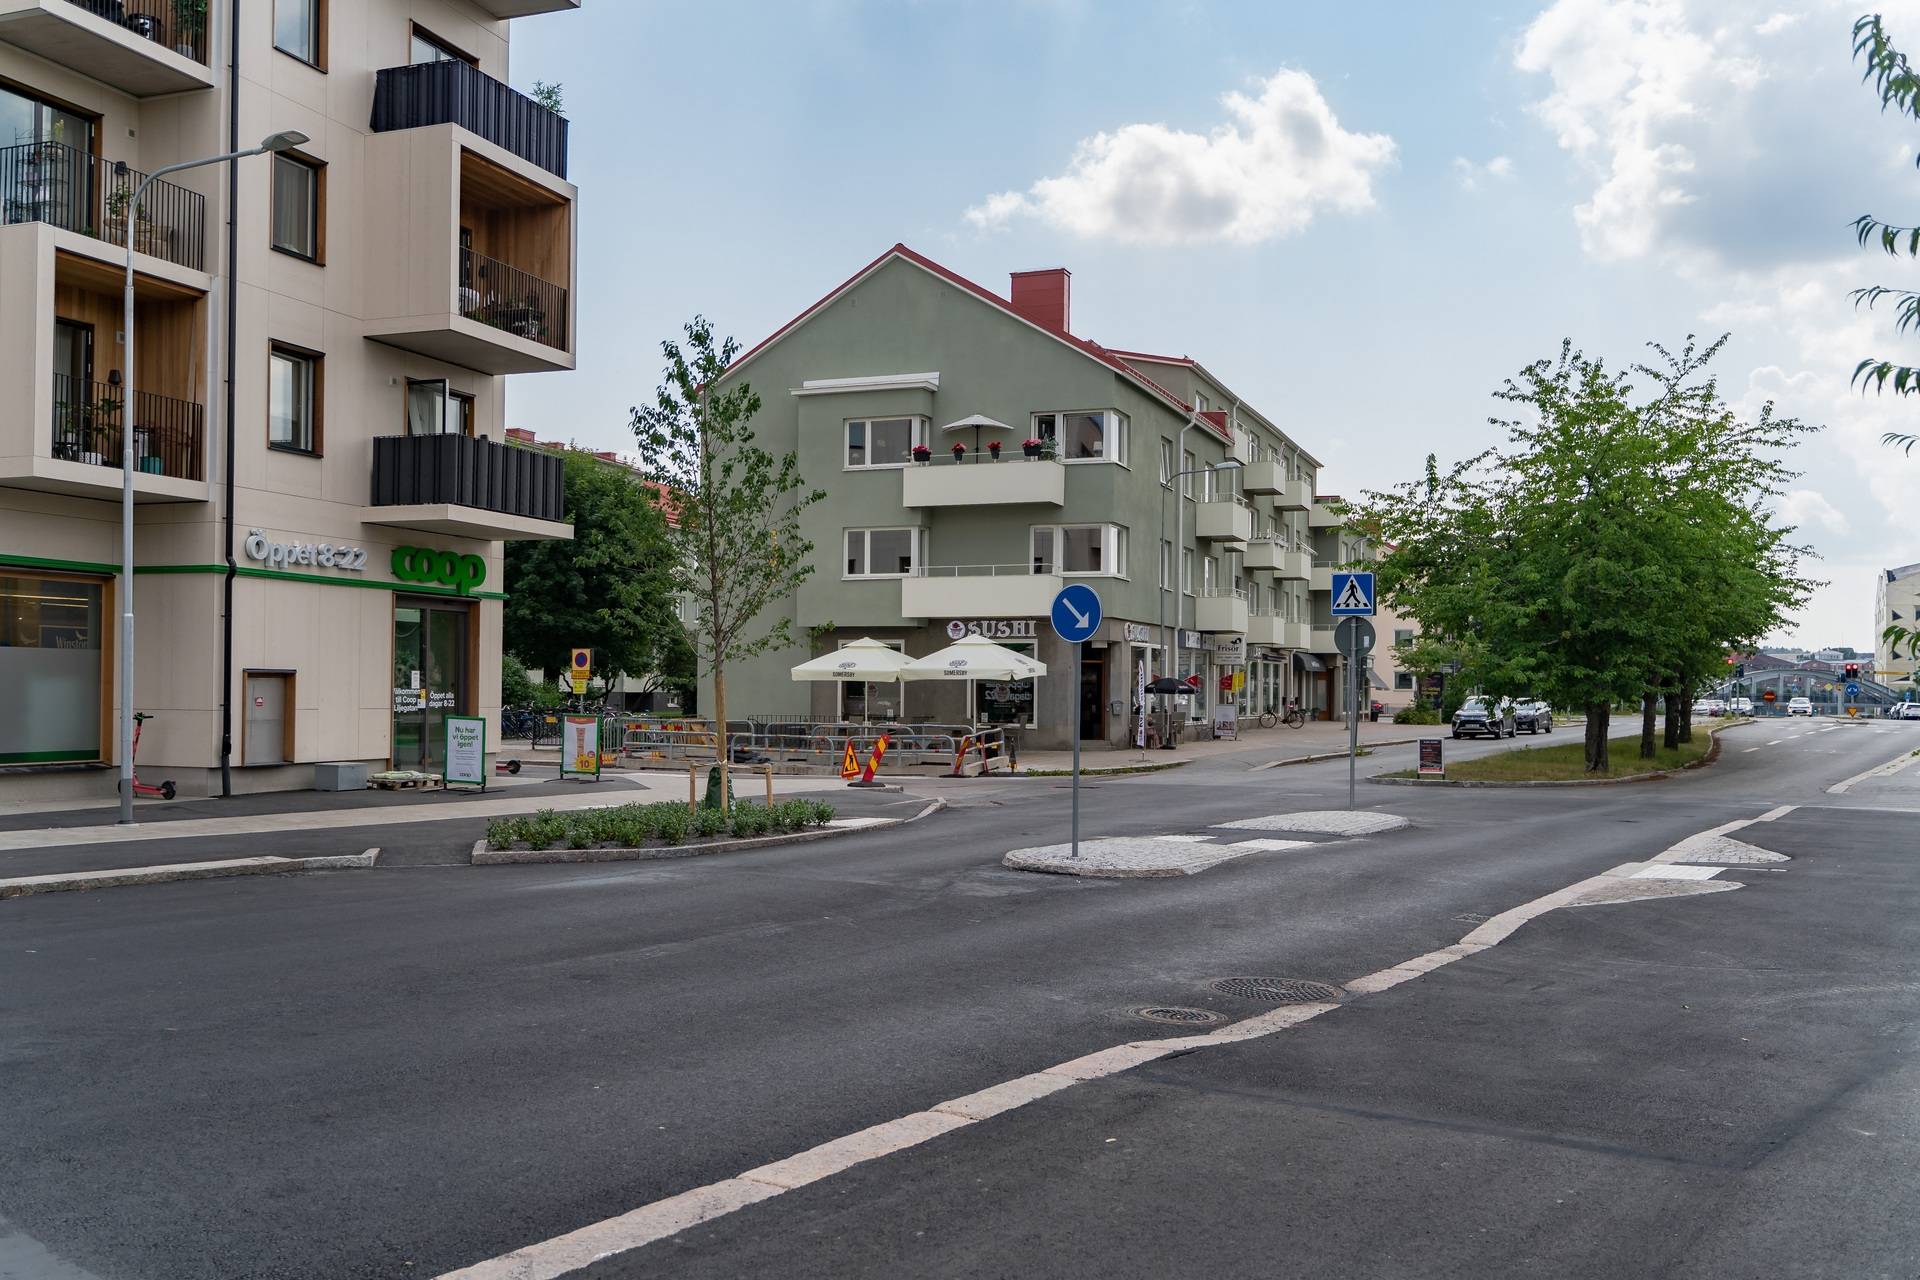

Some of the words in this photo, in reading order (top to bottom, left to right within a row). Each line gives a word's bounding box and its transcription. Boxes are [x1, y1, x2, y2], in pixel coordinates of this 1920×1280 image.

[246, 528, 316, 568] Öppet
[317, 543, 368, 571] 8-22
[391, 545, 486, 595] coop
[967, 620, 1037, 638] SUSHI
[402, 696, 416, 704] Coop
[430, 691, 445, 700] Öppet
[429, 700, 443, 708] dagar
[579, 759, 590, 768] 10
